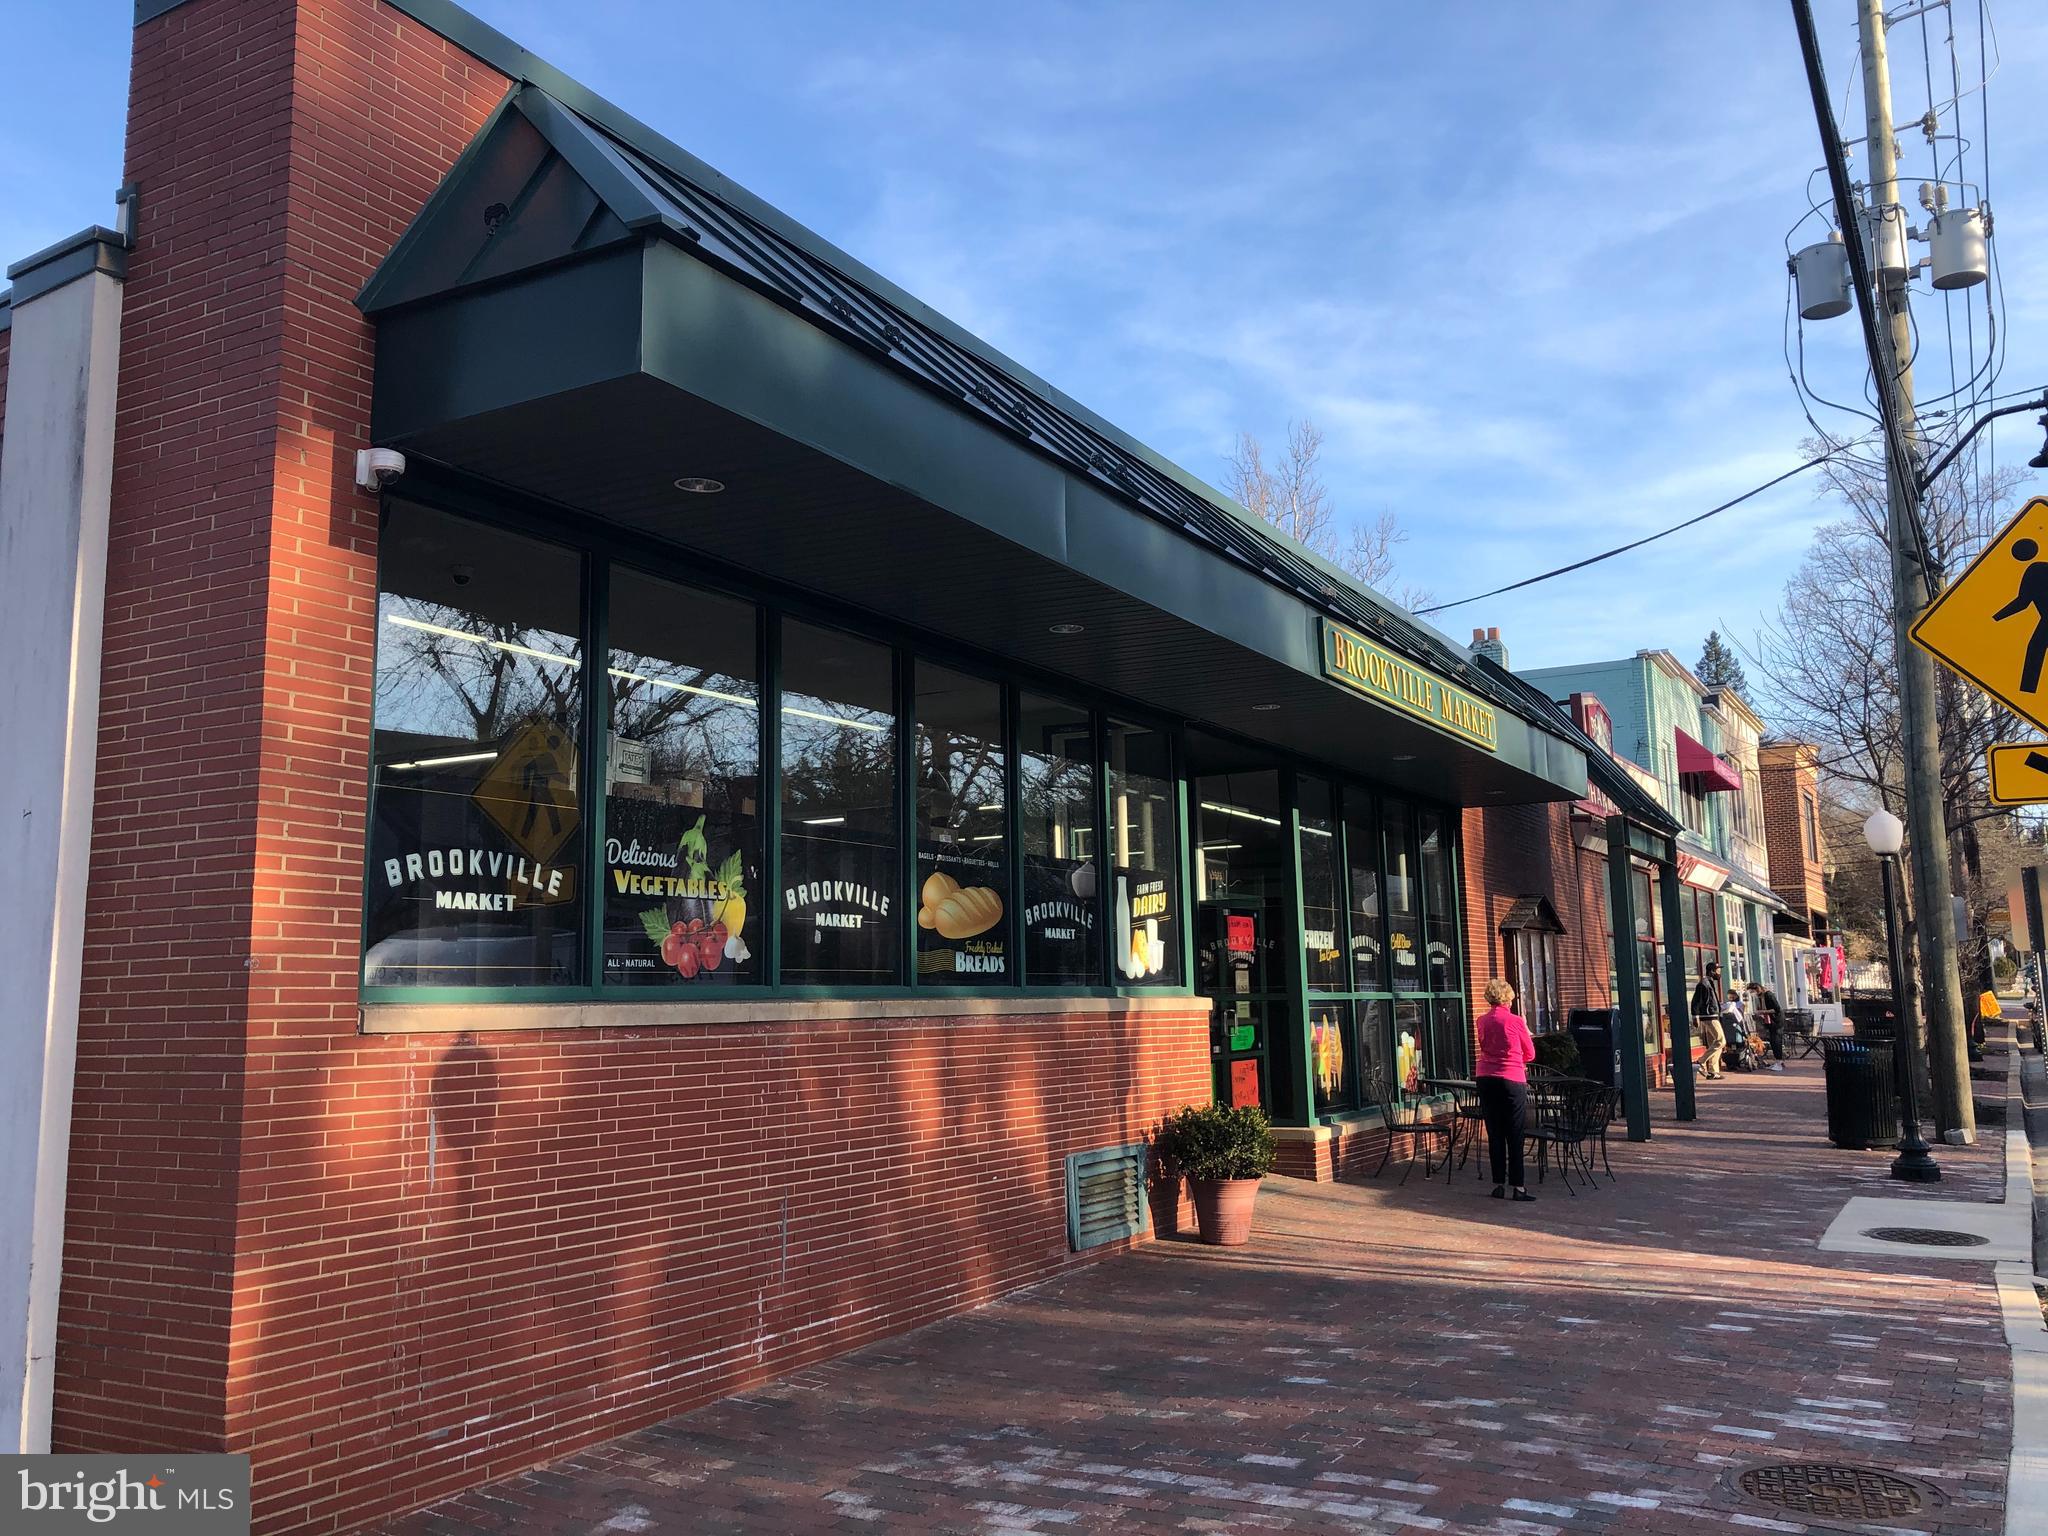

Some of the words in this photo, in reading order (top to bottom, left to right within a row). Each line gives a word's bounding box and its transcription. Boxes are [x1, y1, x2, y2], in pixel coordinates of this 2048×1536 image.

[1333, 631, 1434, 712] BROOKVILLE
[1440, 688, 1494, 740] MARKET
[605, 838, 678, 868] Delicious
[918, 851, 934, 860] BAGELS
[384, 849, 564, 897] BROOKVILLE
[614, 869, 727, 900] VEGETABLES
[1149, 880, 1163, 893] FRESH
[435, 890, 517, 912] MARKET
[785, 880, 890, 916] BROOKVILLE
[1133, 892, 1167, 917] DAIRY
[815, 912, 863, 928] MARKET
[1025, 901, 1094, 930] BROOKVILLE
[1045, 927, 1076, 939] MARKET
[1304, 930, 1334, 949] FROZEN
[607, 958, 621, 968] ALL
[625, 958, 655, 968] NATURAL
[956, 951, 1005, 972] BREADS
